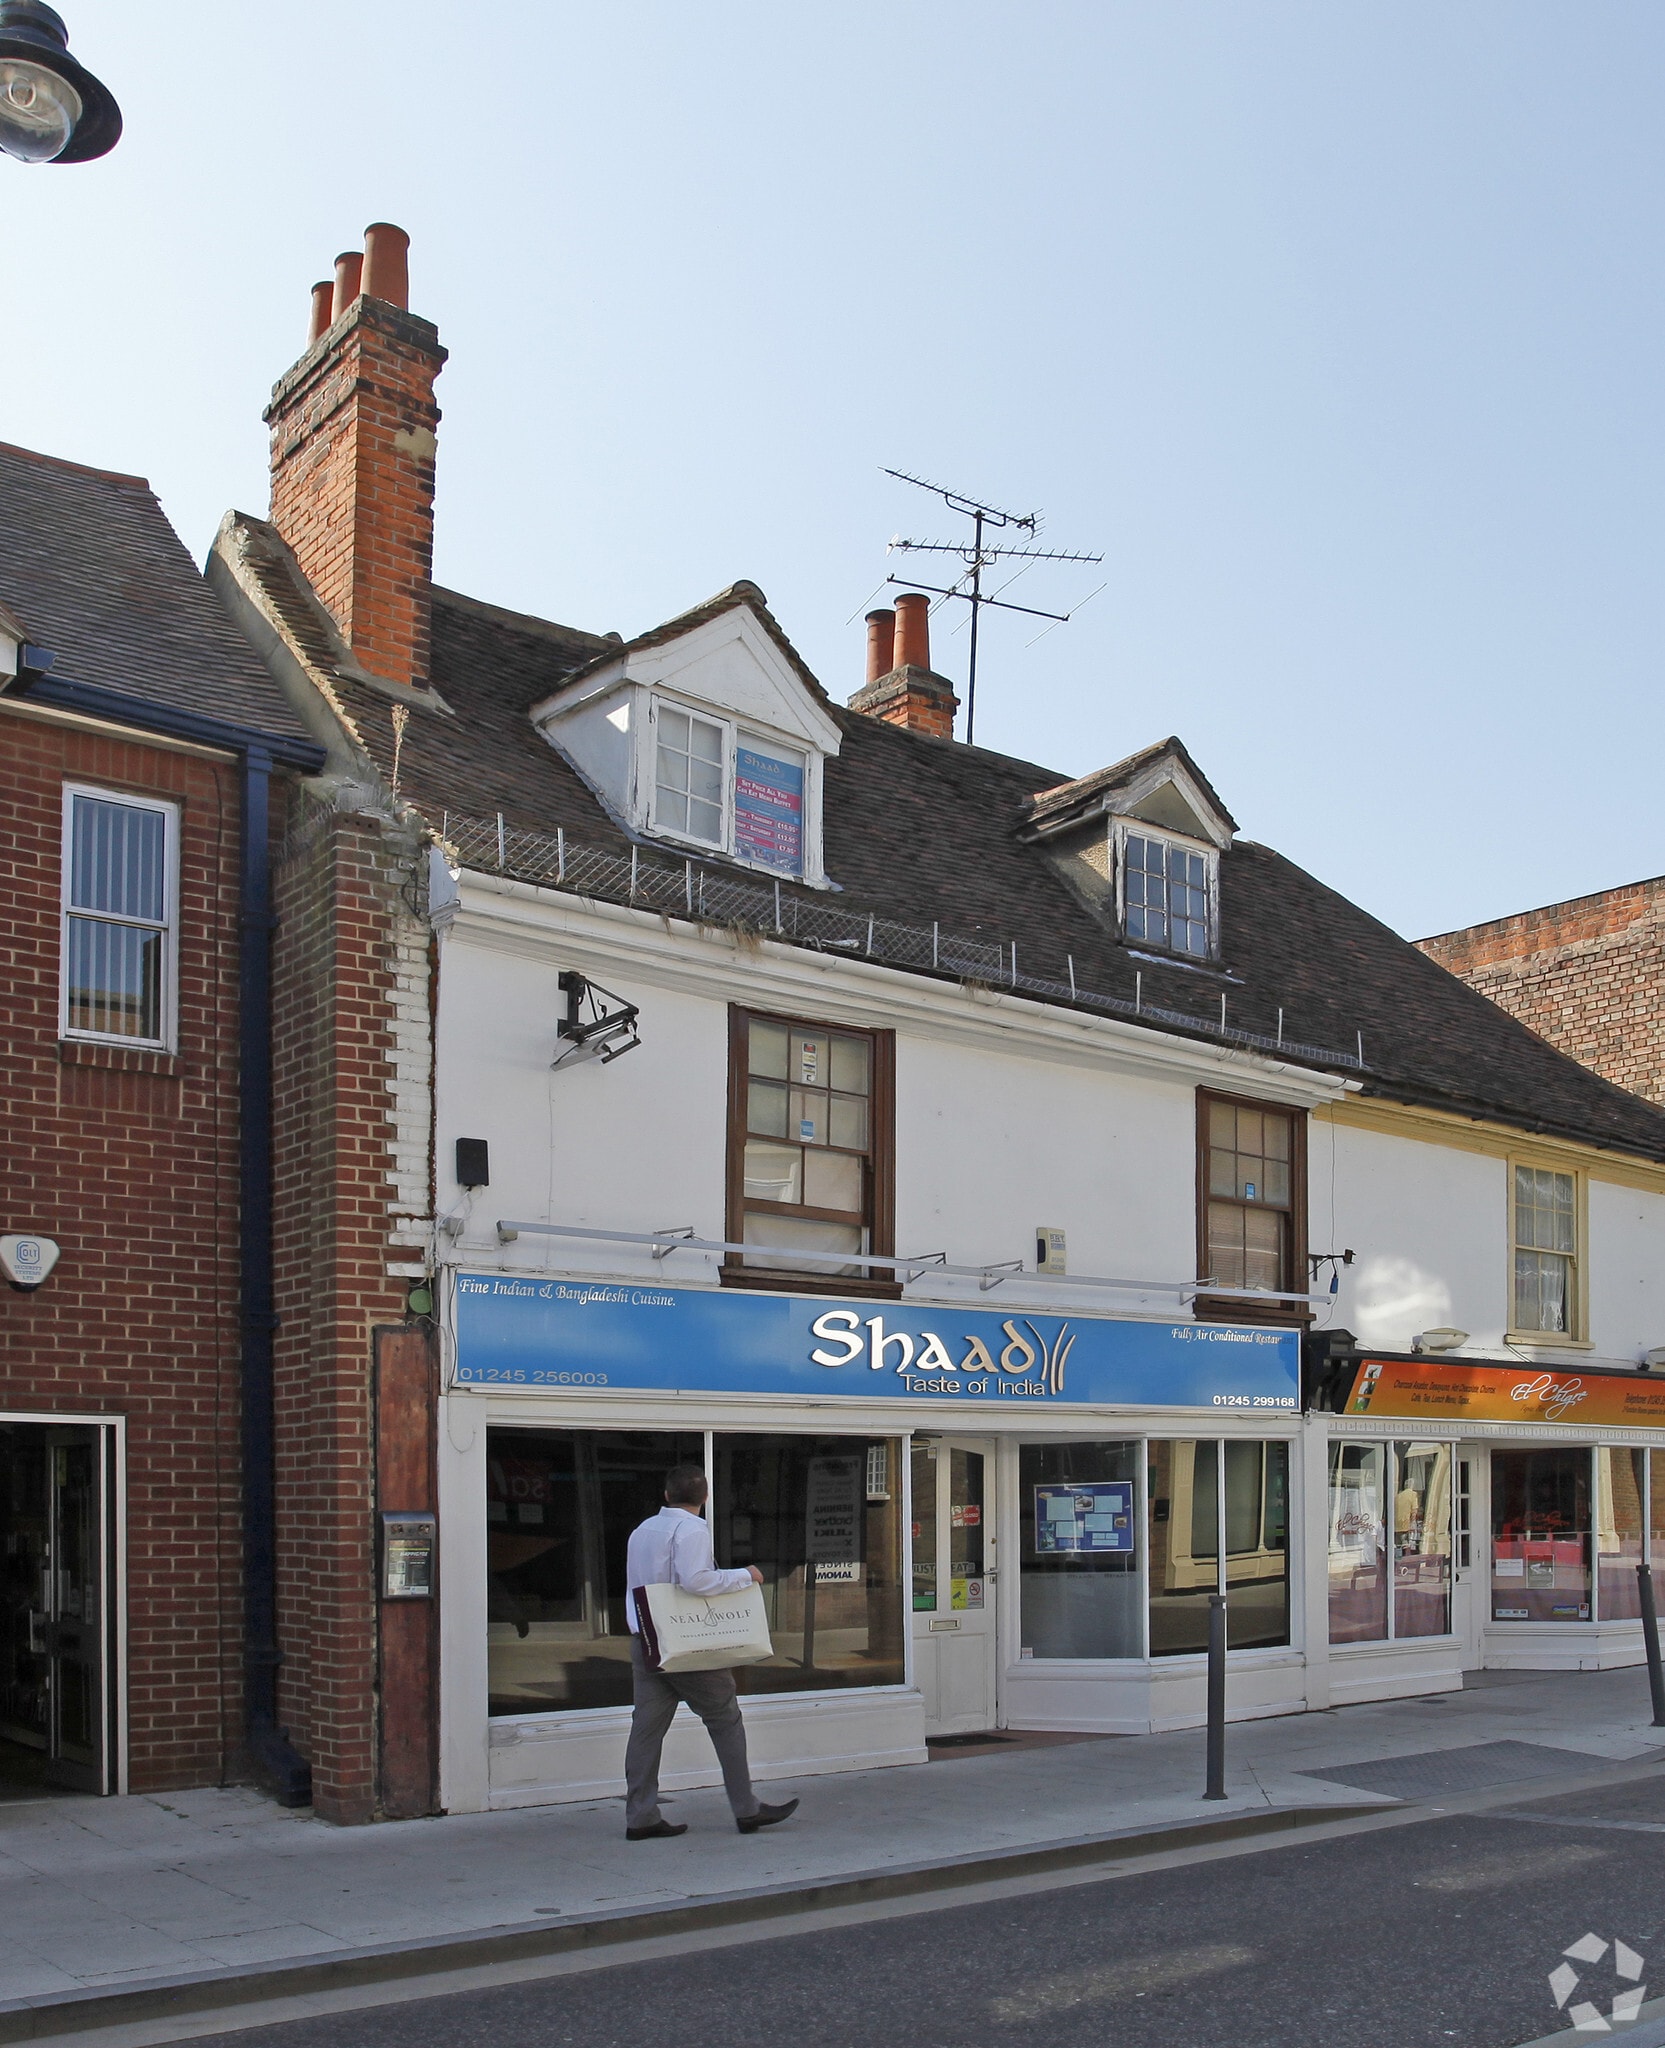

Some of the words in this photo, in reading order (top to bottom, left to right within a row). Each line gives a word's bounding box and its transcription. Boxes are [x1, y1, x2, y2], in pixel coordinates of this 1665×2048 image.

[744, 754, 780, 774] Shaad
[459, 1278, 489, 1294] Fine
[492, 1280, 535, 1297] Indian
[539, 1283, 553, 1299] &
[555, 1284, 629, 1305] Bangladeshi
[631, 1290, 676, 1306] Cuisine.
[811, 1309, 1036, 1375] Shaad
[1172, 1327, 1193, 1343] Fully
[1192, 1329, 1208, 1342] Air
[1208, 1329, 1255, 1343] Conditioned
[1255, 1333, 1293, 1345] Restaur
[460, 1367, 526, 1382] 01245
[532, 1370, 608, 1385] 256003
[899, 1374, 961, 1394] Taste
[967, 1377, 989, 1394] of
[998, 1378, 1046, 1396] India
[1511, 1374, 1552, 1401] El
[1213, 1395, 1250, 1406] 01245
[1253, 1396, 1295, 1407] 299168
